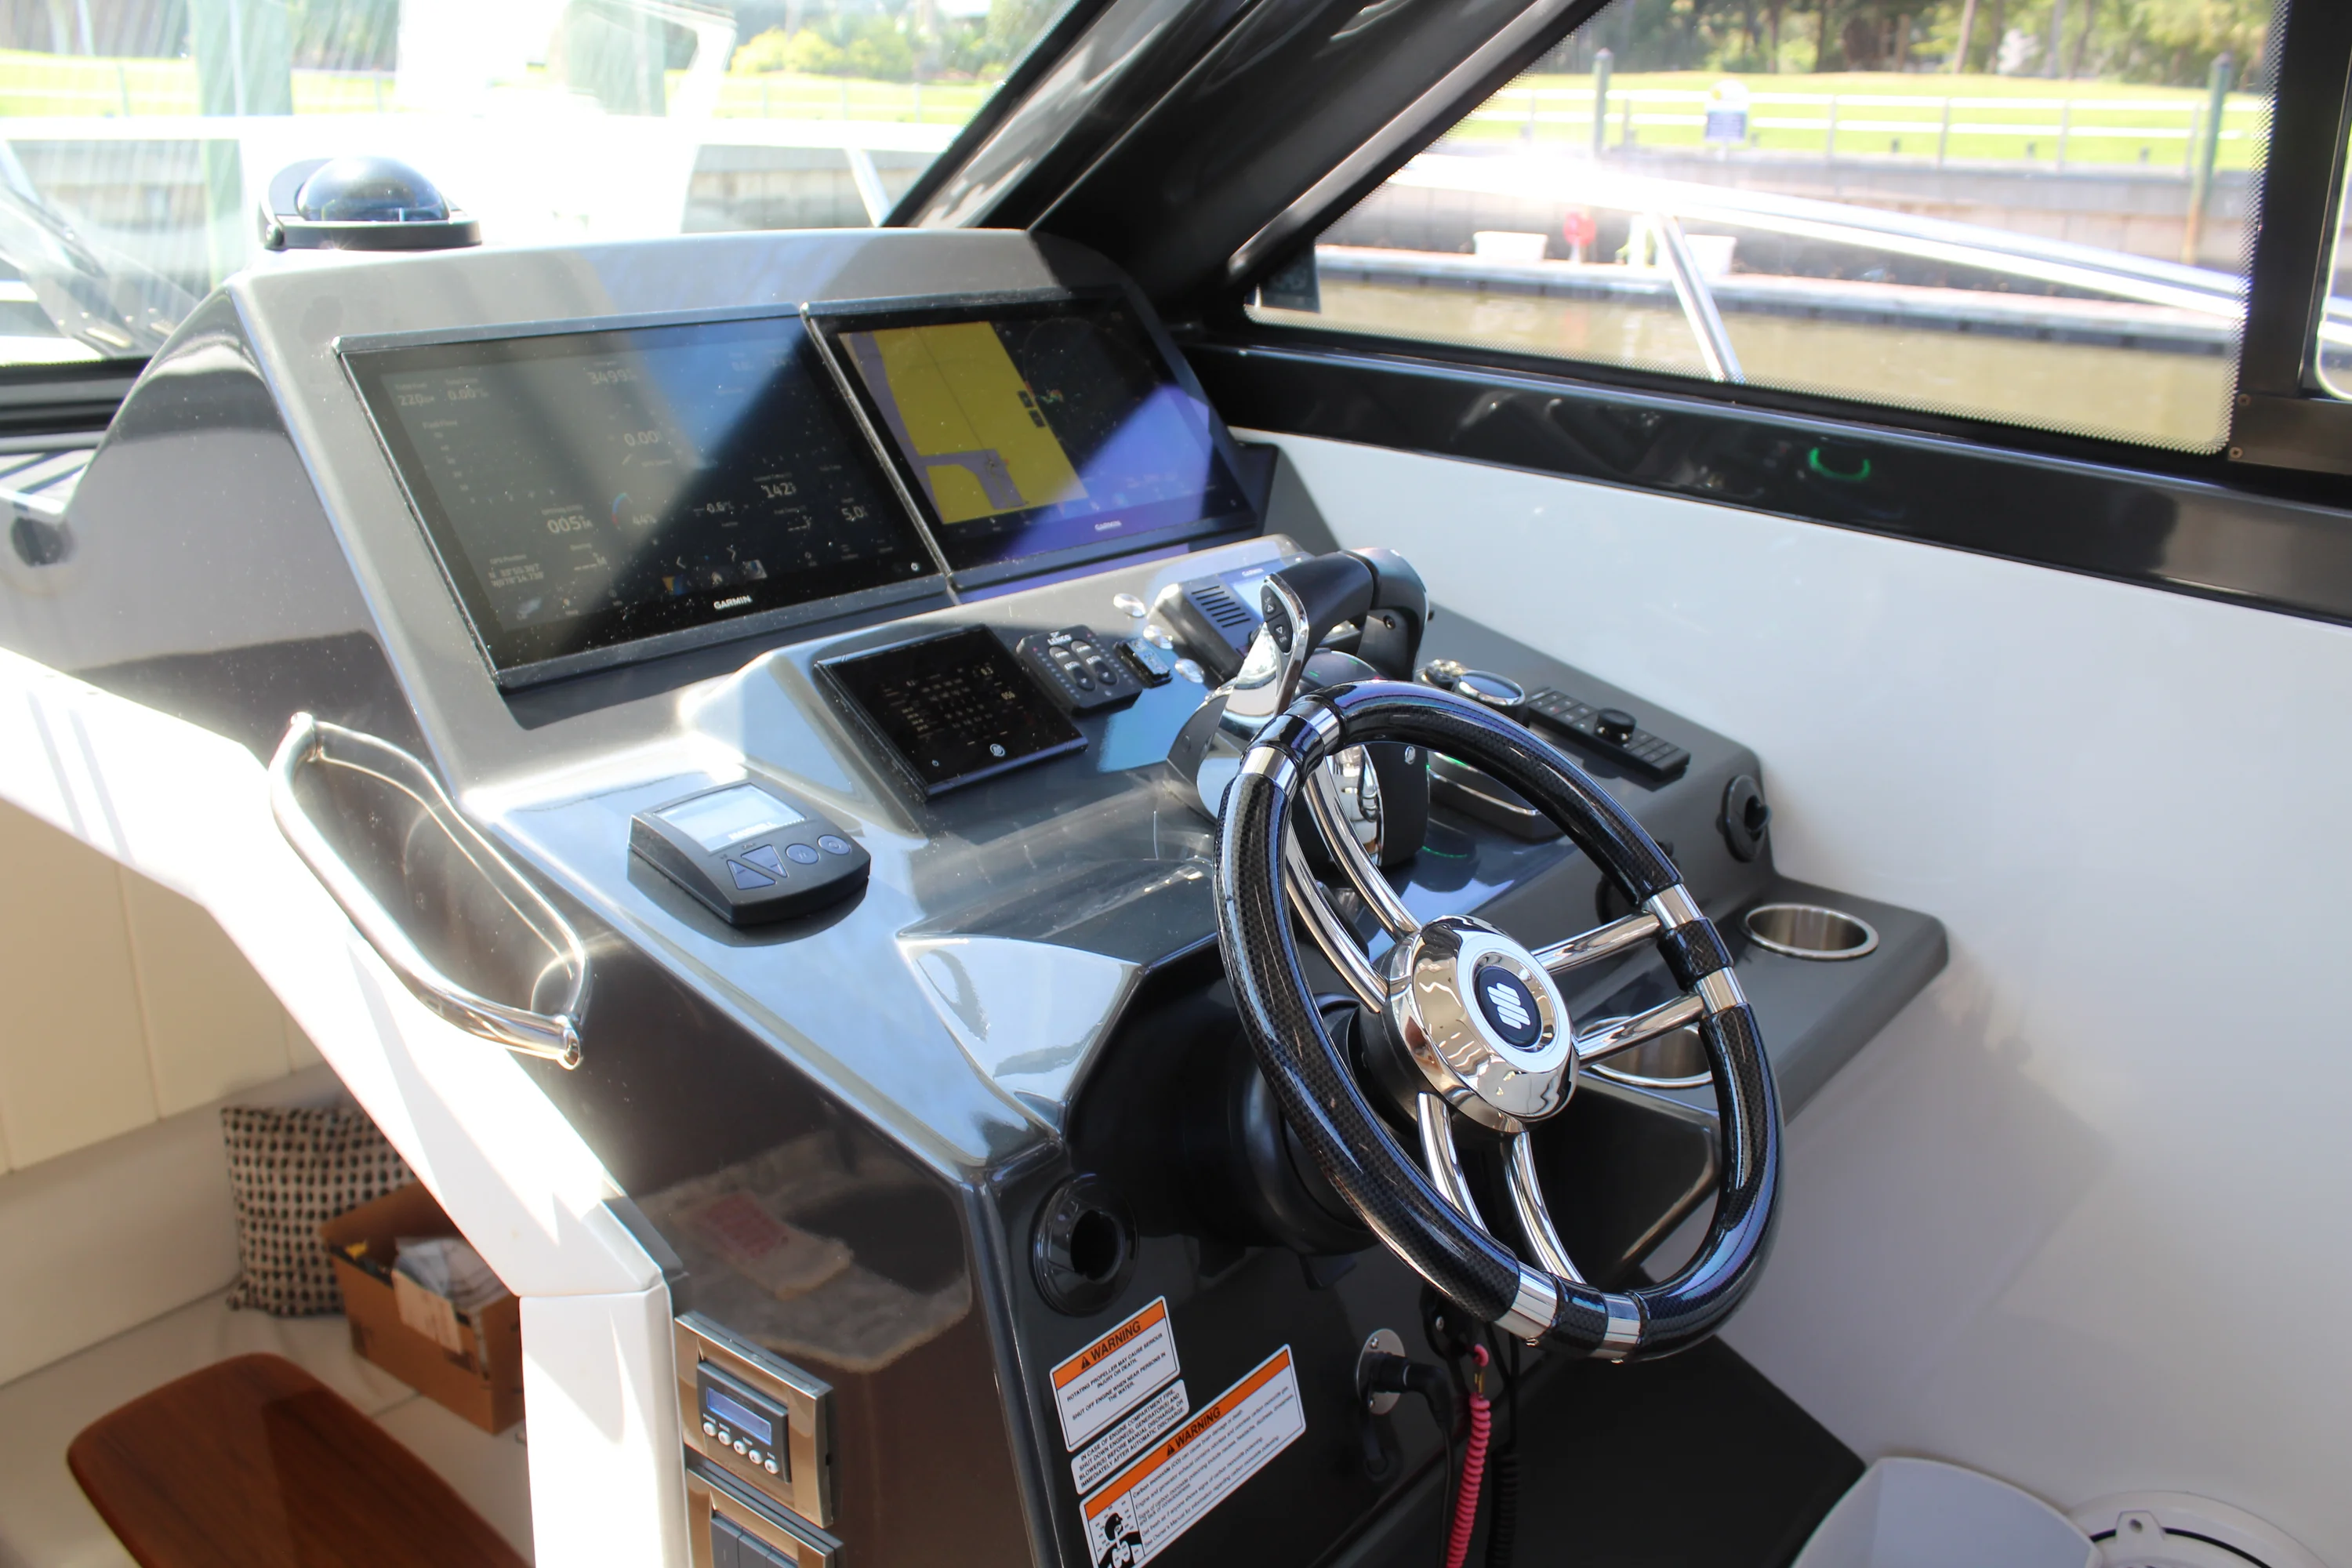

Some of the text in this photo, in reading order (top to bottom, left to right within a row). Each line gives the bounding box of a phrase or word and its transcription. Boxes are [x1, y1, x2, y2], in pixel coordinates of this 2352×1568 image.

[714, 595, 753, 610] GARMIN
[1047, 634, 1072, 645] LENCO
[1091, 1321, 1141, 1360] WARNING
[1067, 1333, 1162, 1401] ROTATING PROPELLER MAY CAUSE SERIOUS
[1073, 1408, 1084, 1420] SHUT
[1086, 1402, 1094, 1411] OFF
[1095, 1389, 1112, 1404] ENGINE
[1113, 1380, 1127, 1391] WHEN
[1127, 1370, 1139, 1381] NEAR
[1140, 1356, 1160, 1372] PERSONS
[1098, 1374, 1112, 1388] INJURY
[1109, 1393, 1117, 1402] THE
[1080, 1458, 1092, 1471] SHUT
[1094, 1446, 1109, 1461] DOWN
[1135, 1402, 1169, 1428] GENERATOR(S)
[1171, 1393, 1179, 1403] AND
[1080, 1457, 1107, 1480] BLOWER(S)
[1107, 1442, 1127, 1459] BEFORE
[1127, 1428, 1147, 1443] MANUAL
[1176, 1399, 1183, 1407] OR
[1087, 1444, 1100, 1457] CASE
[1109, 1425, 1127, 1440] ENGINE
[1128, 1398, 1162, 1425] COMPARTMENT
[1175, 1406, 1221, 1447] WARNING
[1081, 1462, 1112, 1487] IMMEDIATELY
[1114, 1448, 1129, 1463] AFTER
[1131, 1428, 1156, 1450] AUTOMATIC
